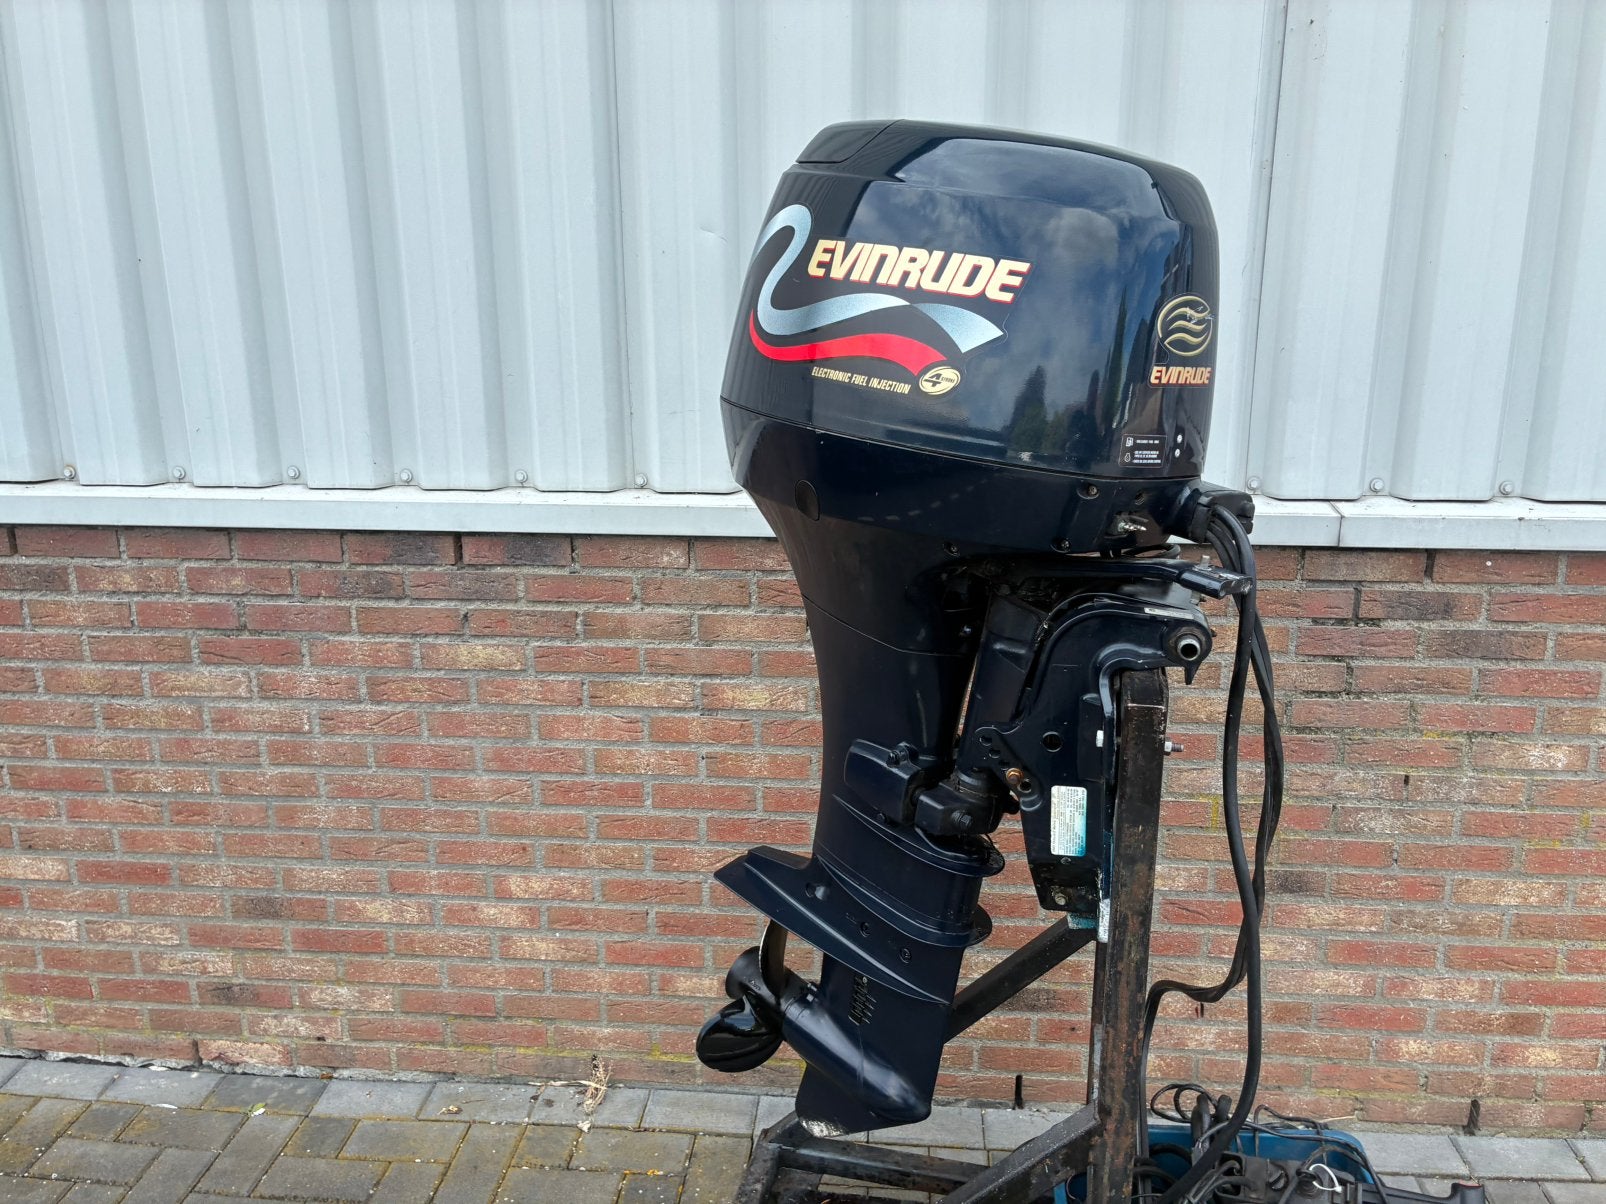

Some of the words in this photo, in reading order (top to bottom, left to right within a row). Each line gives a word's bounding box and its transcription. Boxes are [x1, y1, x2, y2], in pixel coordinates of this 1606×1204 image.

[807, 239, 1032, 303] EVINRUDE
[811, 366, 852, 383] ELECTRONIC
[851, 374, 868, 386] FUEL
[868, 377, 911, 395] INJECTION
[923, 373, 942, 387] 4
[1150, 366, 1212, 386] EVINRUDE
